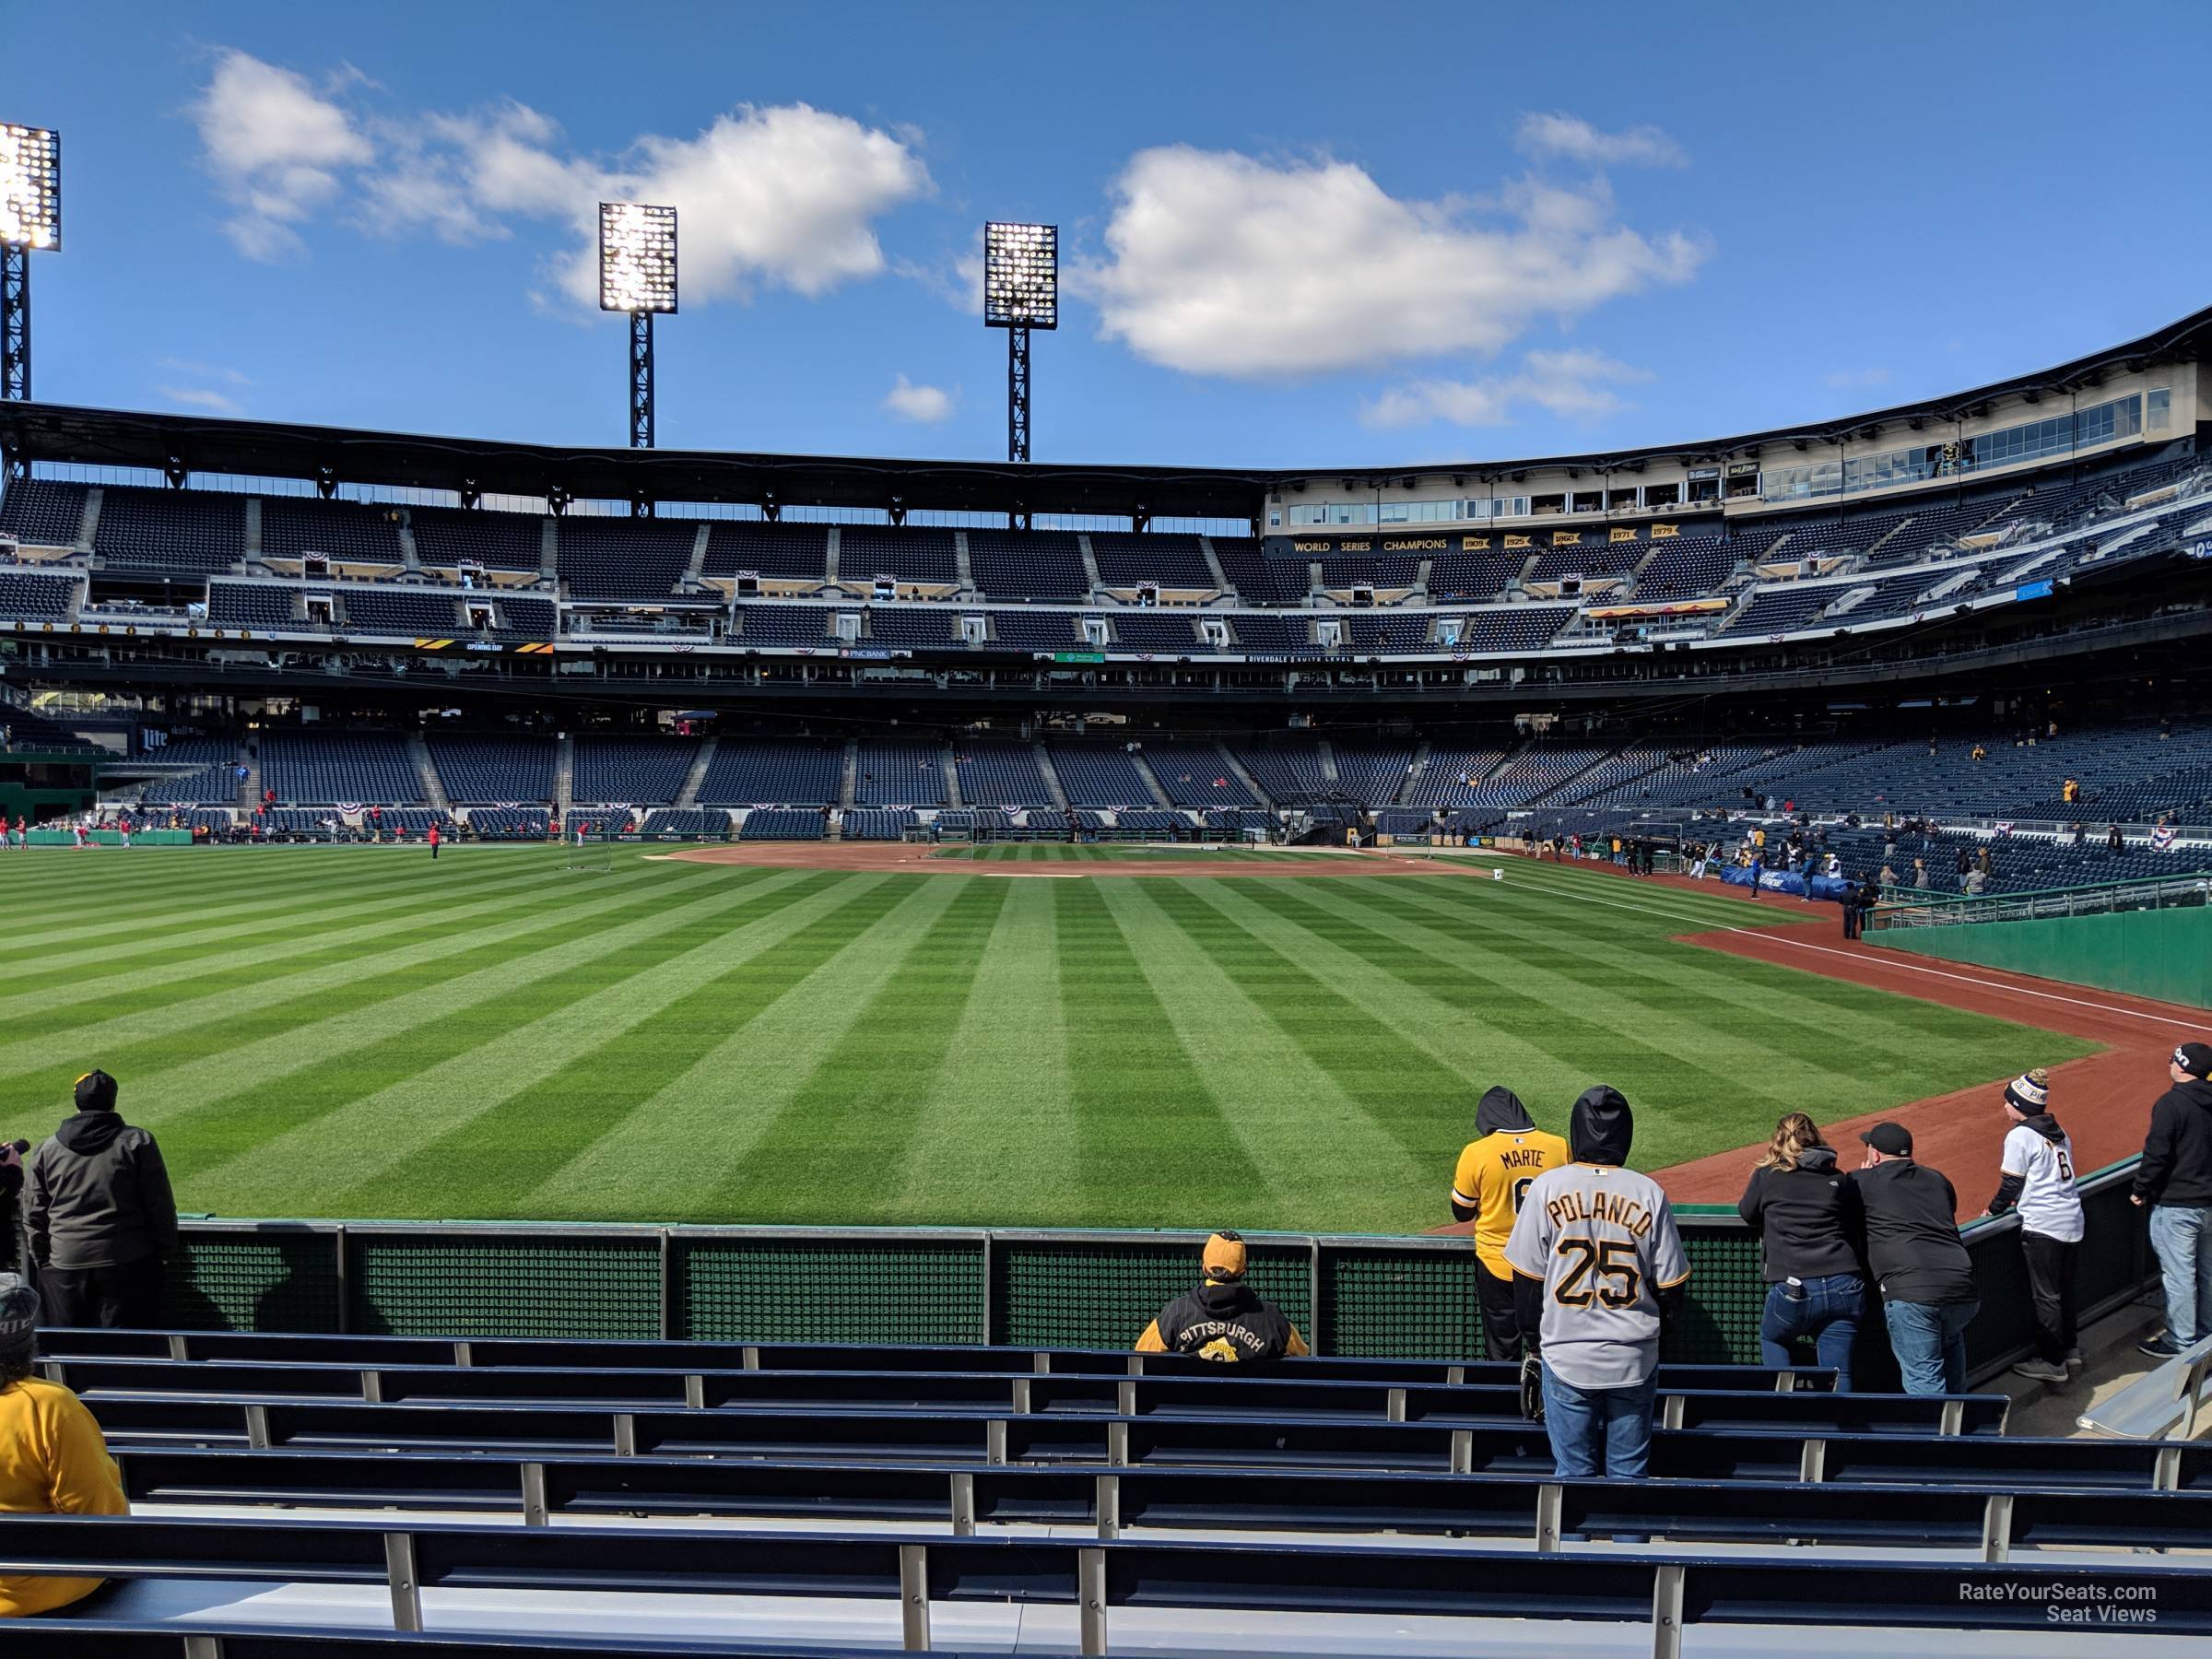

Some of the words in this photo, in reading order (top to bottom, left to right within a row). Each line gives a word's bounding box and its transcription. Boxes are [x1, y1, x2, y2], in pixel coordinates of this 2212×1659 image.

[1294, 542, 1331, 553] WORLD
[1340, 541, 1371, 552] SERIES
[1383, 539, 1447, 551] CHAMPIONS
[1500, 1149, 1546, 1170] MARTE
[2057, 1151, 2072, 1182] 6
[1547, 1192, 1653, 1239] POLANCO
[1554, 1236, 1641, 1309] 25
[1180, 1321, 1265, 1353] PITTSBURGH
